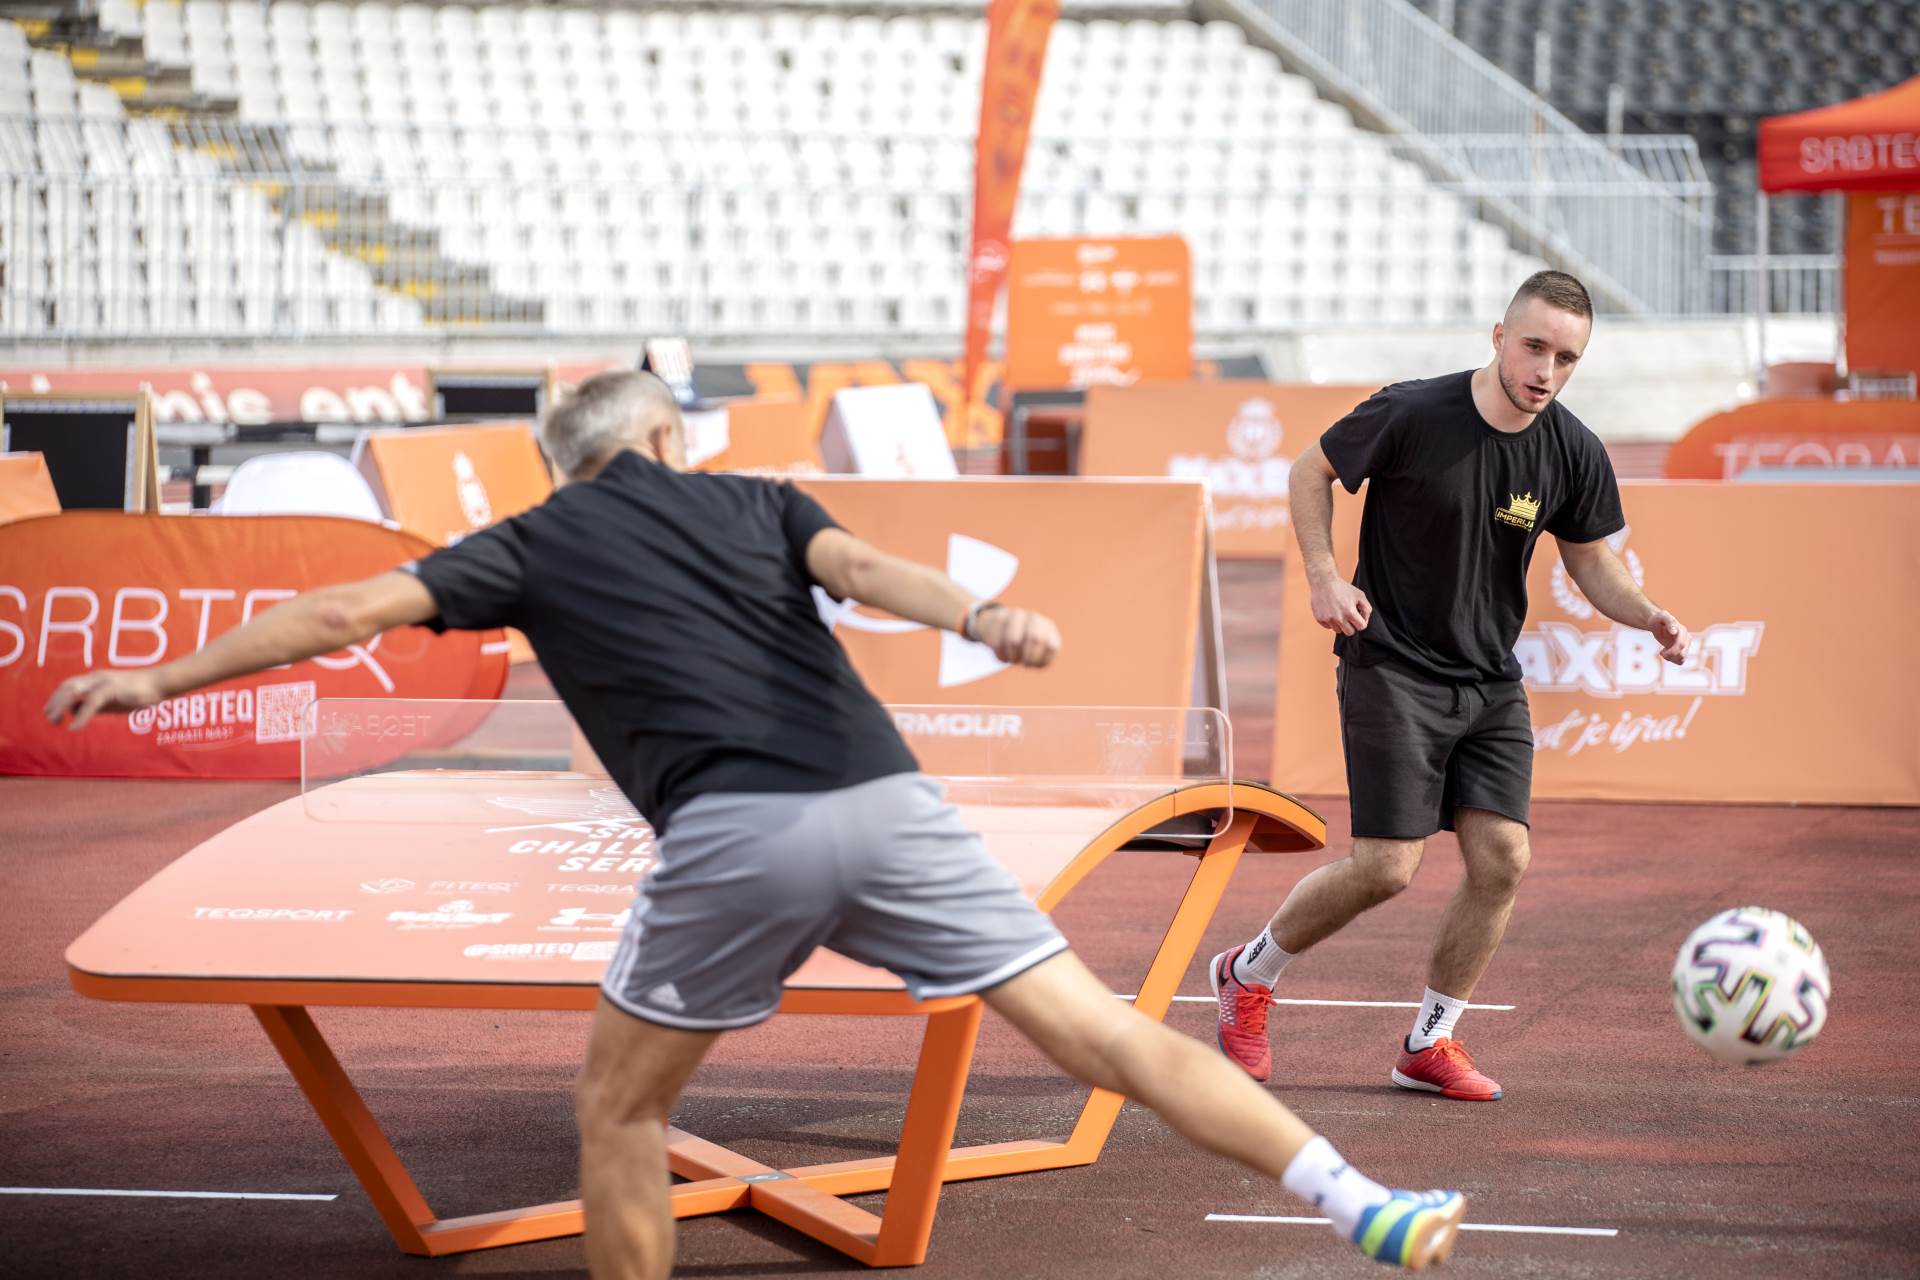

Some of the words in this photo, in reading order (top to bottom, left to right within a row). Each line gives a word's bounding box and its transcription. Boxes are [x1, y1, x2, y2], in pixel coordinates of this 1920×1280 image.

[1800, 132, 1920, 174] SRBTE
[1513, 621, 1765, 699] AXBET
[128, 689, 254, 735] @SRBTEQ
[894, 711, 1023, 737] RMOUR
[588, 826, 656, 839] SR
[193, 907, 354, 921] TEQSPORT
[1421, 1002, 1446, 1037] SPORT
